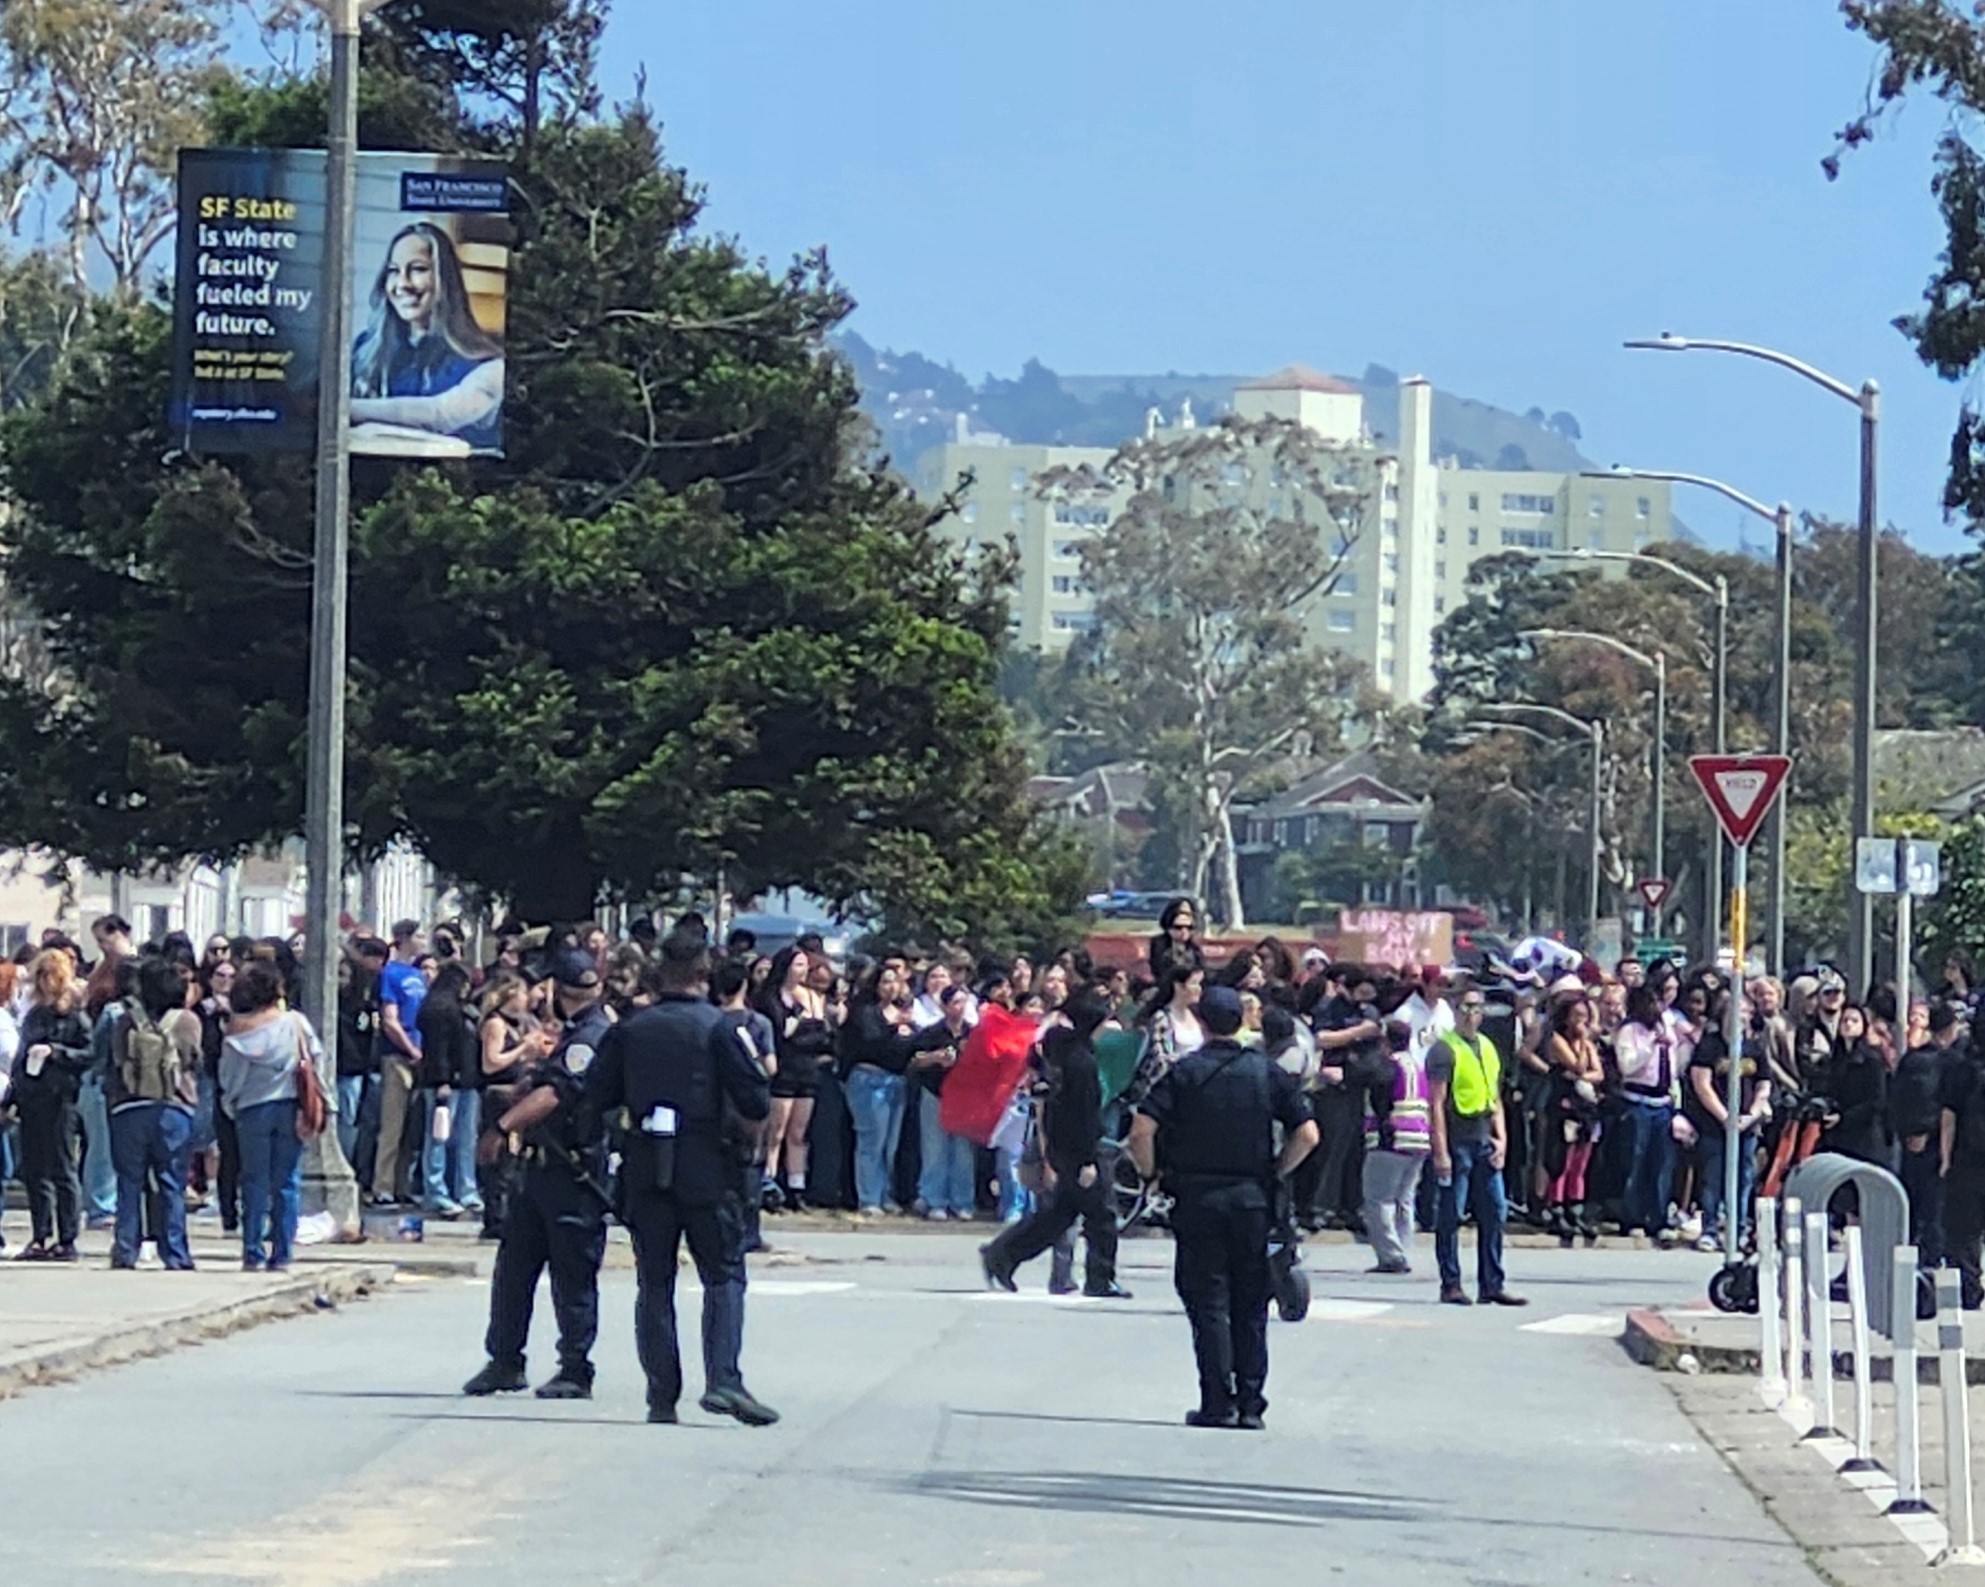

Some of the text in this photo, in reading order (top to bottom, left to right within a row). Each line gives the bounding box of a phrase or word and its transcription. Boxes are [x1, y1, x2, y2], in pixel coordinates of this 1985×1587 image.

[200, 196, 298, 220] SF State
[199, 223, 298, 249] is where
[198, 252, 280, 282] faculty
[196, 282, 313, 313] fueled my
[195, 311, 277, 336] future.
[1725, 778, 1759, 790] YIELD
